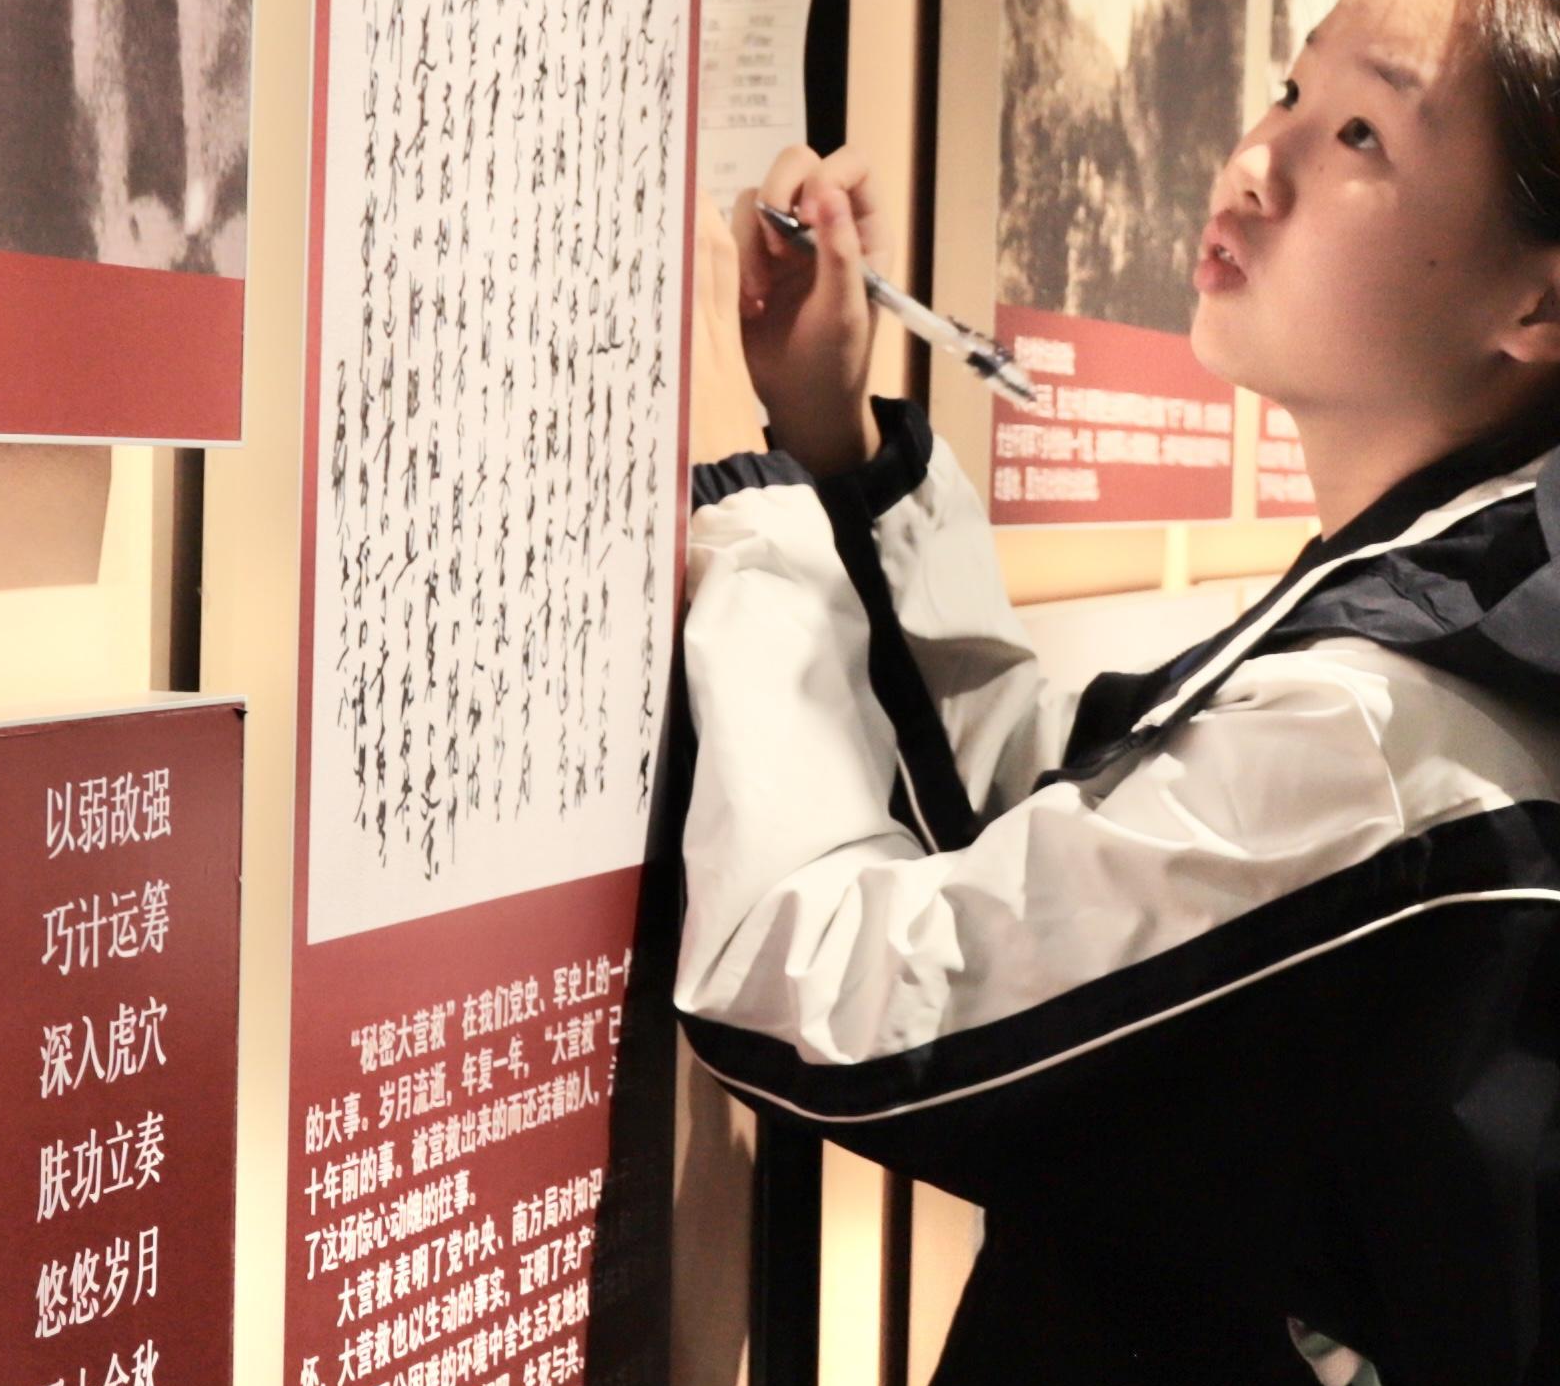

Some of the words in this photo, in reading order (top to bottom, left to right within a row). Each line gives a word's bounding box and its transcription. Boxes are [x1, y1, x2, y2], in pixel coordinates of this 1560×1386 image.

[47, 768, 171, 859] 以弱敌强
[42, 879, 170, 975] 巧计运筹
[40, 996, 168, 1099] 深入虎穴
[37, 1110, 164, 1223] 肤功立奏
[305, 1169, 475, 1280] 了这场惊心动魄的往事。
[36, 1225, 159, 1338] 悠悠岁月
